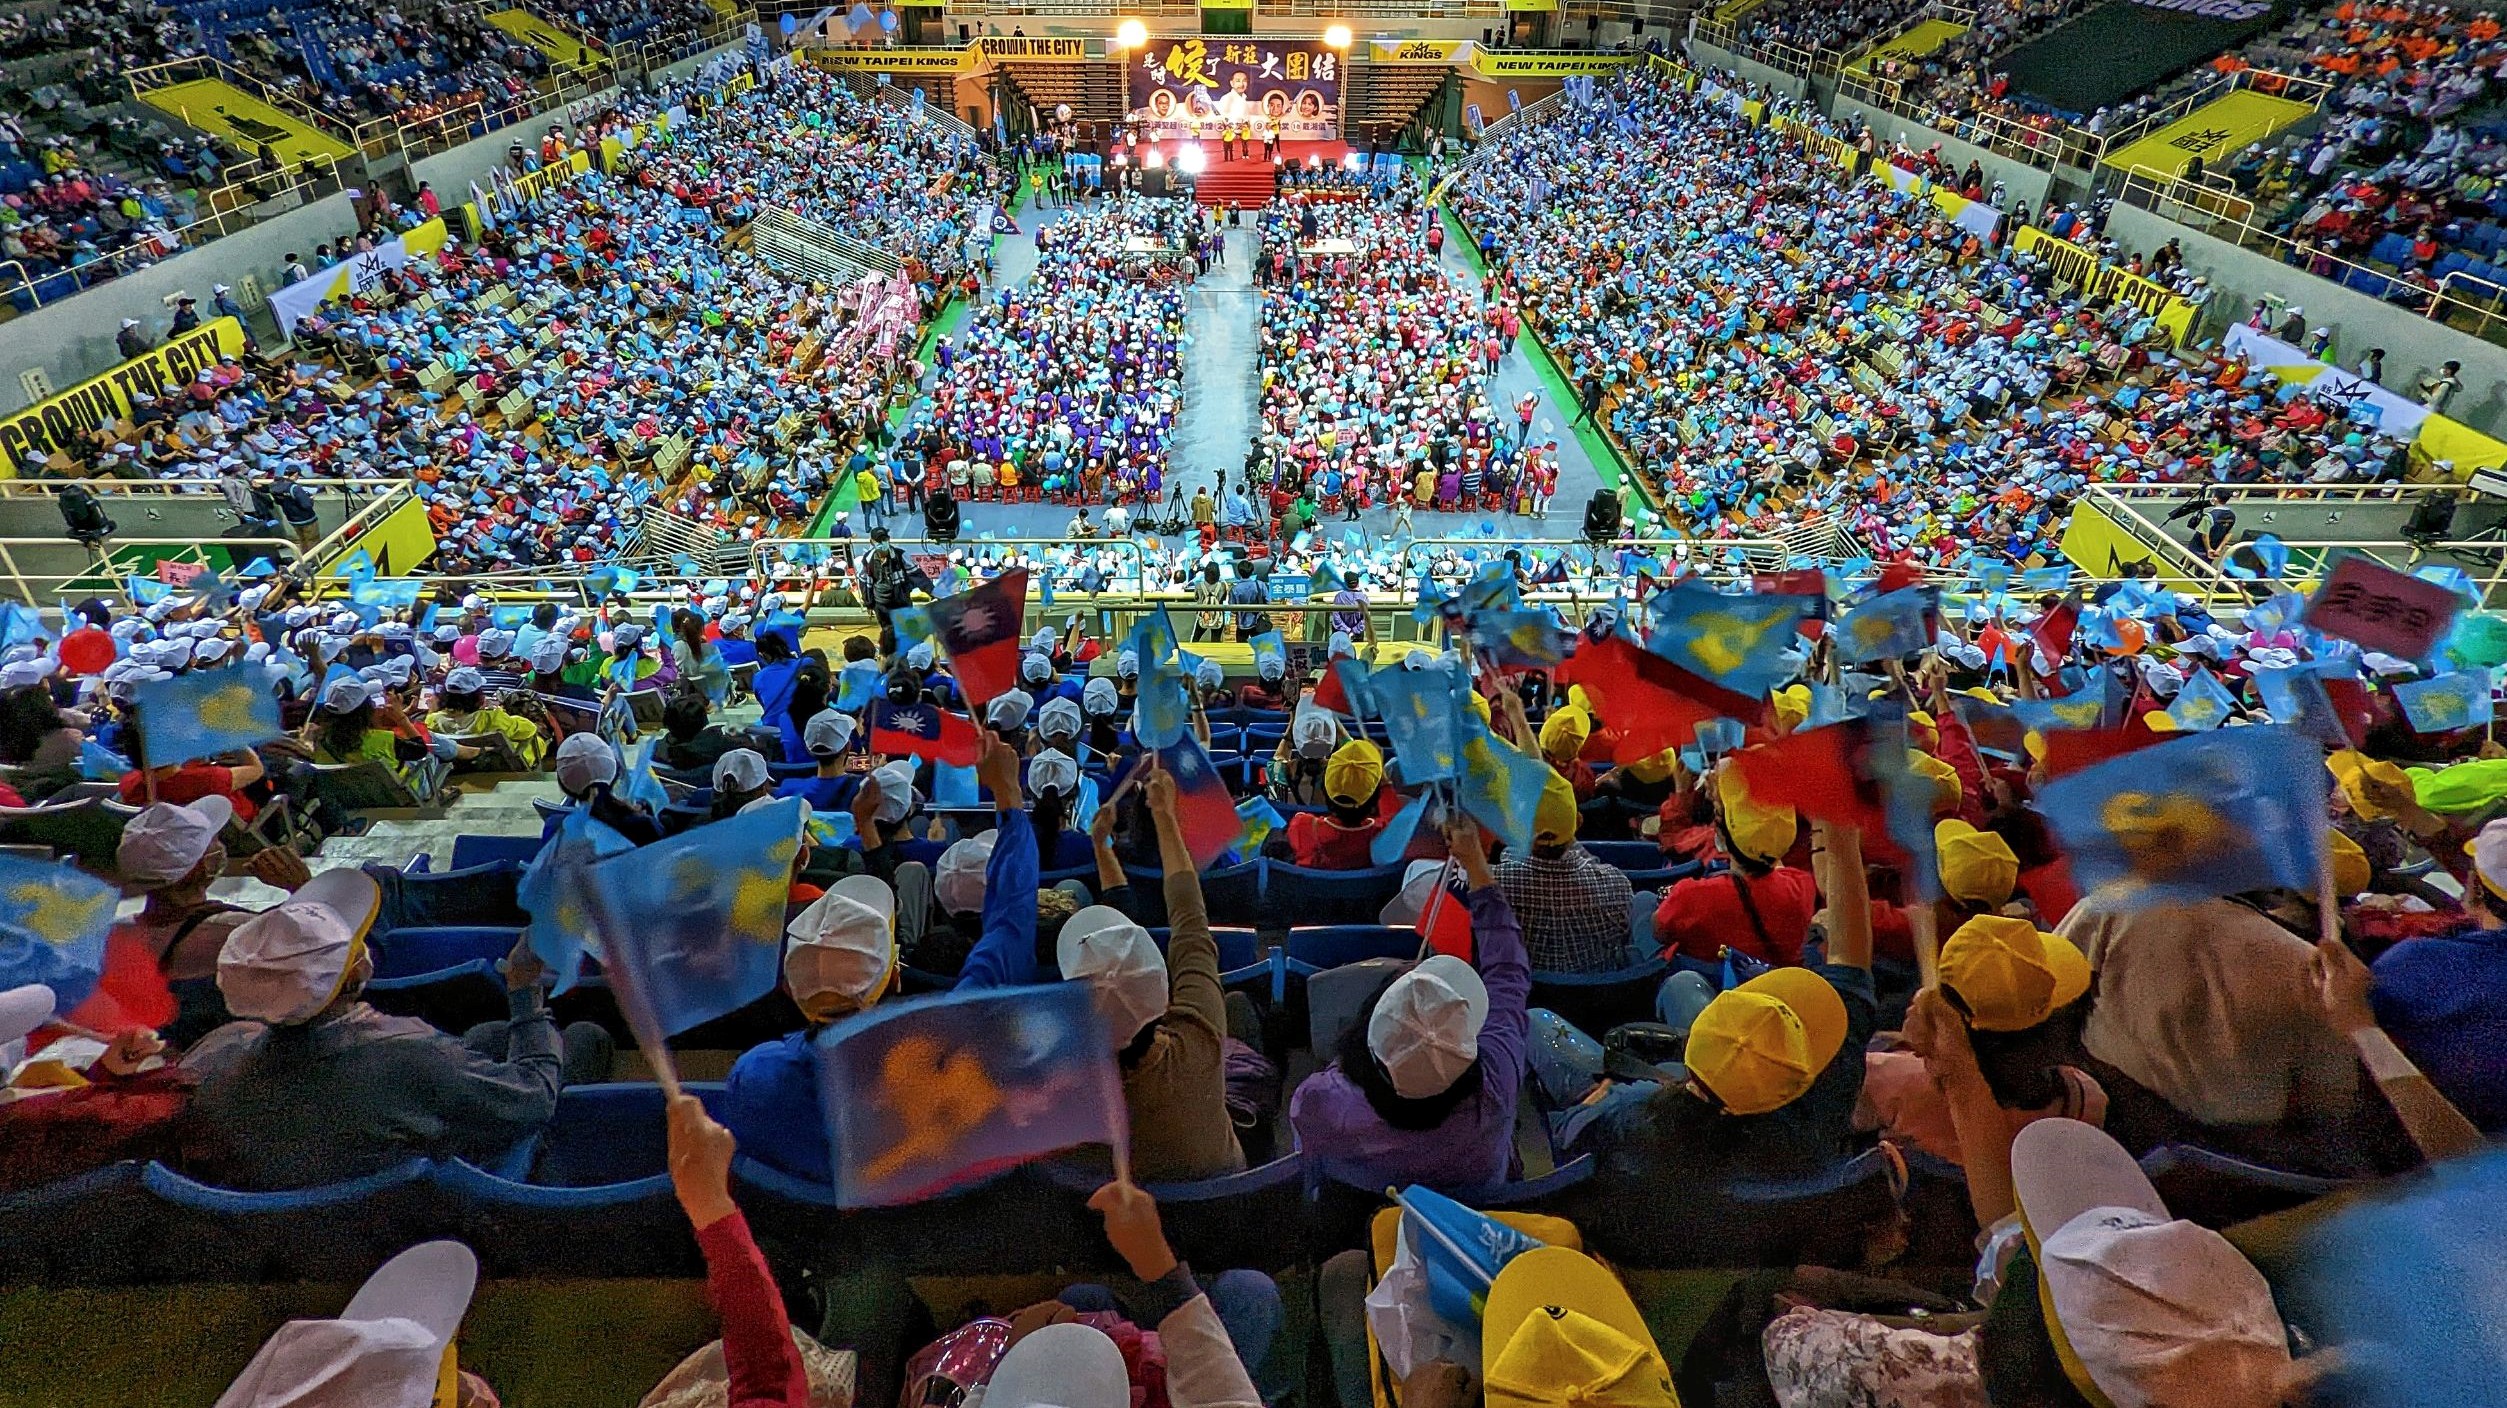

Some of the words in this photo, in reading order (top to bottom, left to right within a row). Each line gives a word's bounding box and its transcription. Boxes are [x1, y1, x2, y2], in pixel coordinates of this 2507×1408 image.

[982, 39, 1027, 55] CROWN
[1029, 39, 1052, 55] THE
[1053, 39, 1081, 56] CITY
[1400, 51, 1443, 60] KINGS
[863, 57, 913, 66] TAIPEI
[915, 58, 959, 66] KINGS
[1258, 51, 1336, 81] 大團結
[1496, 61, 1533, 70] NEW
[1536, 61, 1585, 70] TAIPEI
[0, 379, 122, 469] CROWN
[165, 328, 223, 388] CITY
[1272, 584, 1306, 594] 全泰里
